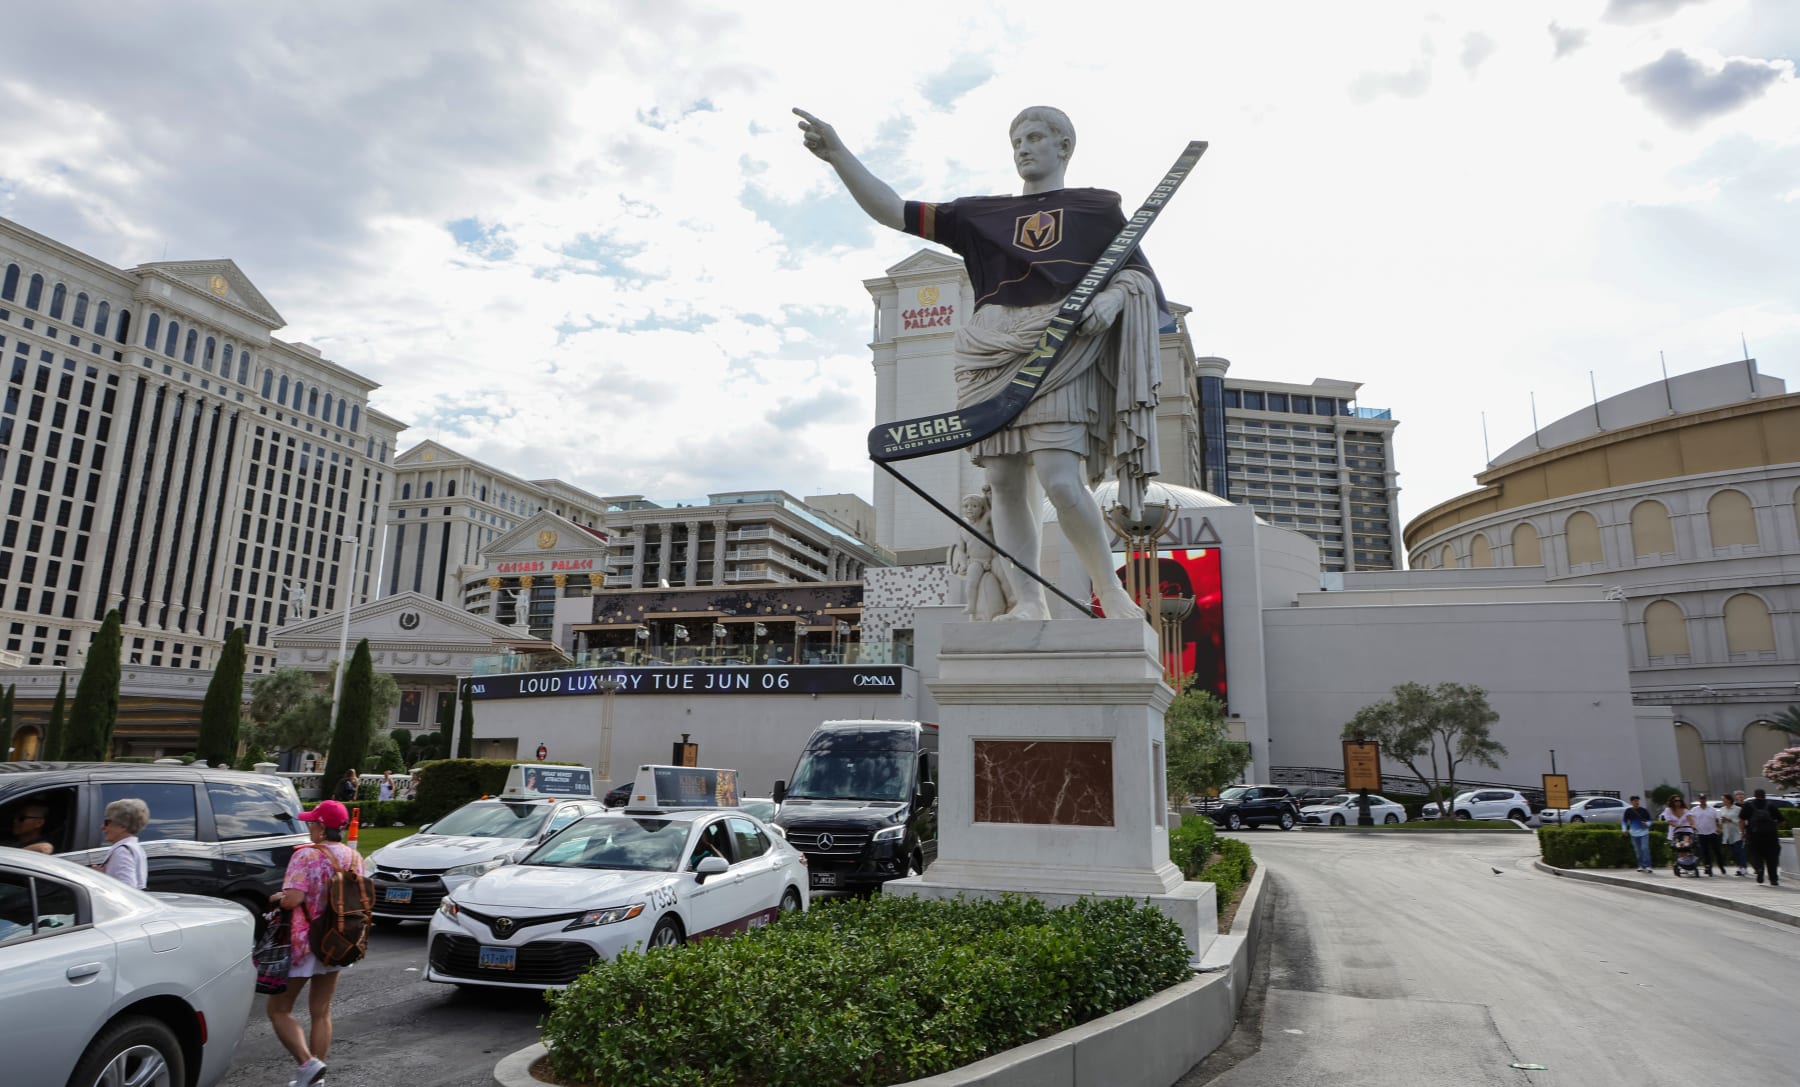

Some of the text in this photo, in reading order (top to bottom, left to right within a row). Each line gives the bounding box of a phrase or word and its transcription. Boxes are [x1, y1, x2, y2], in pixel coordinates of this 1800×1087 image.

[1064, 171, 1185, 311] VEGAS GOLDEN KNIGHTS
[901, 304, 954, 320] CAESARS
[904, 315, 951, 330] PALACE
[888, 415, 963, 444] VEGAS
[885, 431, 972, 453] GOLDEN KNIGHTS
[496, 559, 593, 574] CAESARS PALACE
[519, 677, 561, 693] LOUD
[652, 674, 694, 689] TUE
[705, 673, 750, 689] JUN
[762, 673, 790, 689] 06
[853, 674, 895, 686] OMNIA
